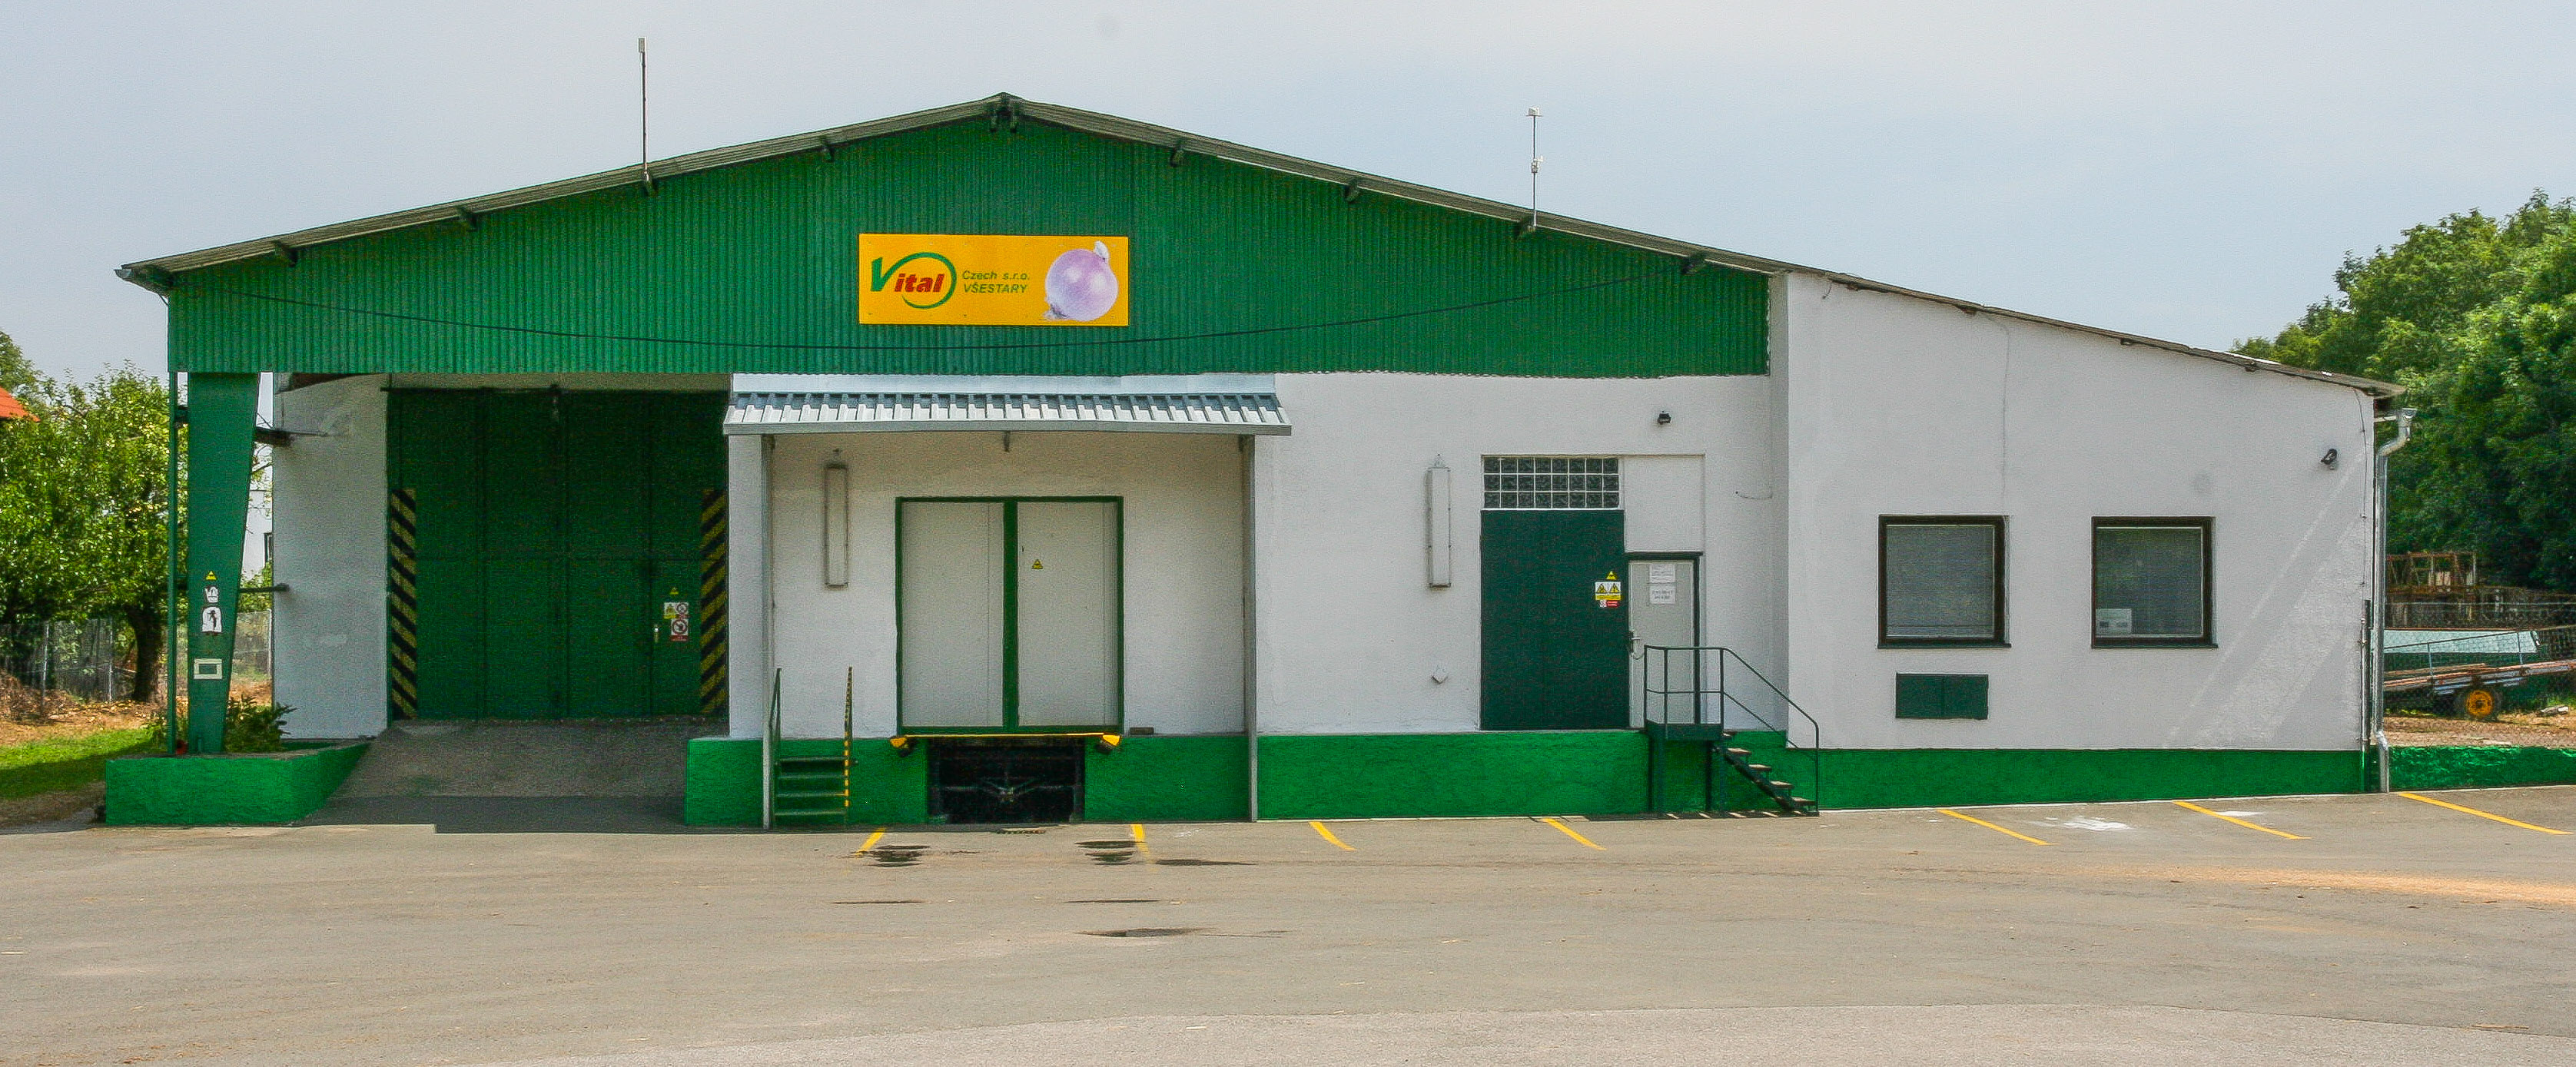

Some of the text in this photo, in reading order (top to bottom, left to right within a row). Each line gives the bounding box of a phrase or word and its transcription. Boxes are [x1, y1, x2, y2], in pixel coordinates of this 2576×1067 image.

[870, 252, 957, 309] Vital
[963, 270, 1029, 280] Czech s.r.o.
[964, 282, 1027, 293] VŠESTARY
